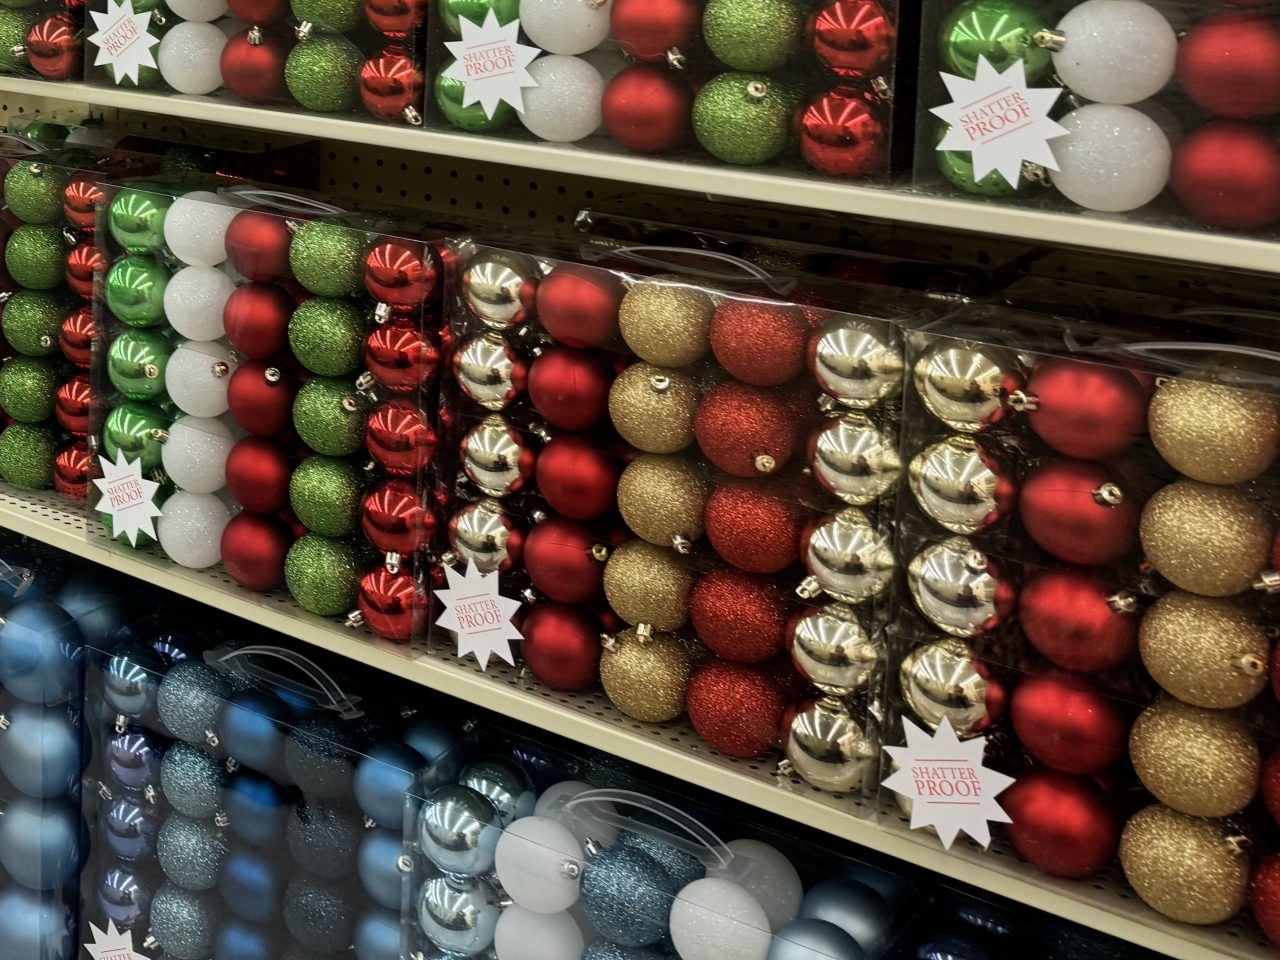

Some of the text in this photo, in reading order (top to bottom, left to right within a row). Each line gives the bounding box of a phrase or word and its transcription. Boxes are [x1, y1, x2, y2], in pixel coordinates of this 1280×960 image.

[106, 25, 138, 56] PROOF
[463, 45, 513, 64] SHATTER
[464, 54, 515, 77] PROOF
[959, 92, 1024, 125] SHATTER
[965, 101, 1031, 141] PROOF
[107, 479, 141, 496] SHATTER
[109, 487, 143, 507] PROOF
[454, 600, 498, 616] SHATTER
[457, 609, 502, 629] PROOF
[912, 767, 978, 779] SHATTER
[915, 780, 982, 797] PROOF
